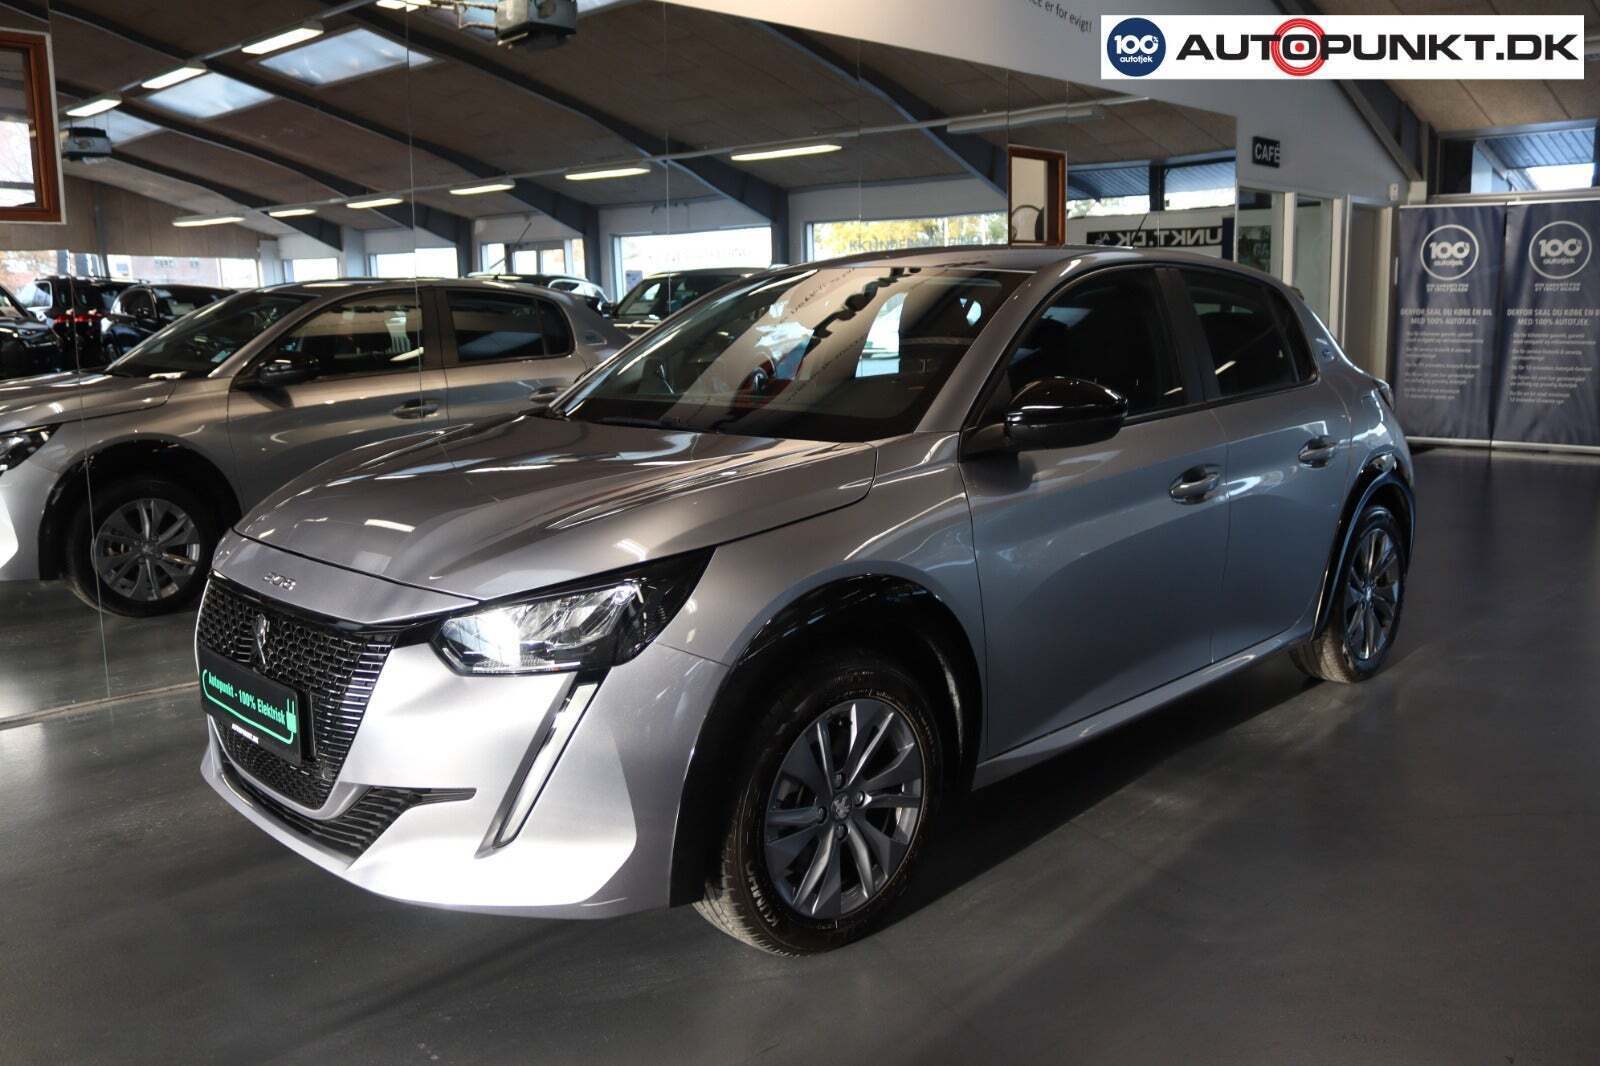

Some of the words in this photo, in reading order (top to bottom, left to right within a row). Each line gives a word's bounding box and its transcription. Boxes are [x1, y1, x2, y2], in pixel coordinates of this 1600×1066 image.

[1056, 3, 1068, 19] for
[1255, 143, 1280, 163] CAFÉ
[208, 671, 235, 698] Autopunkt
[238, 689, 257, 711] 100%
[257, 698, 286, 727] Elektrisk
